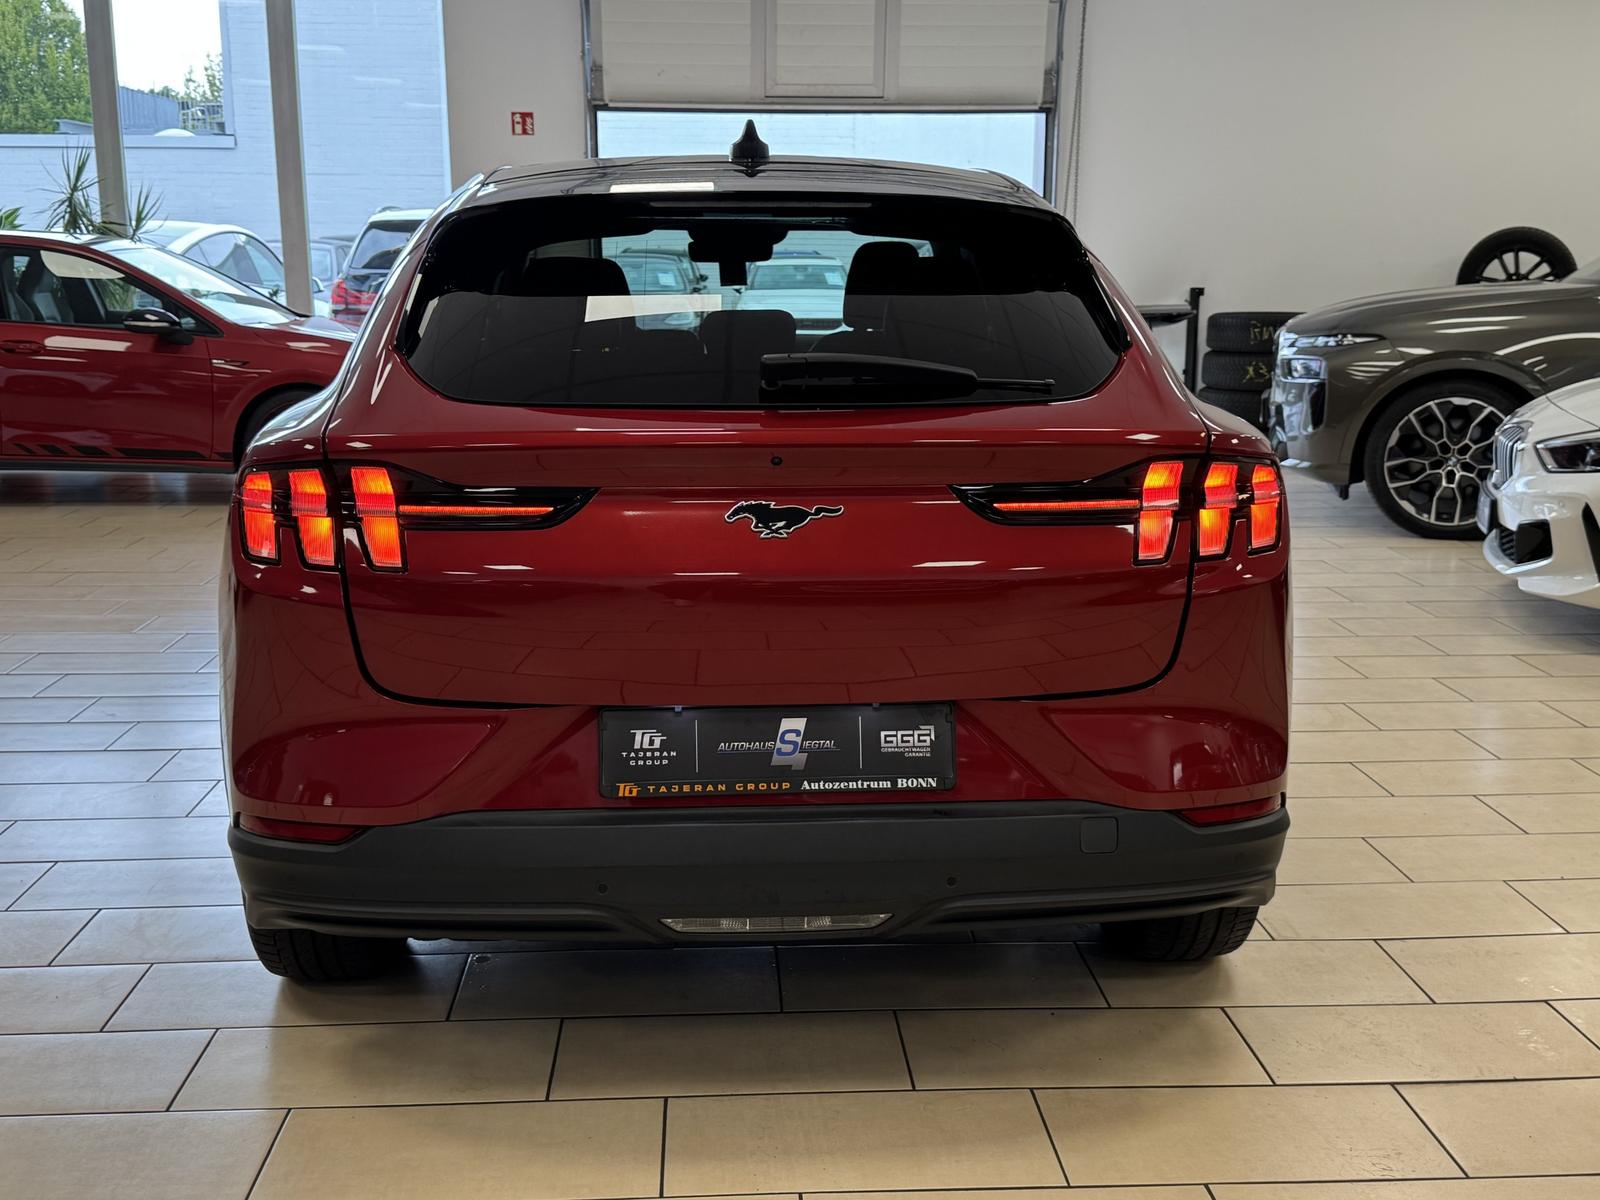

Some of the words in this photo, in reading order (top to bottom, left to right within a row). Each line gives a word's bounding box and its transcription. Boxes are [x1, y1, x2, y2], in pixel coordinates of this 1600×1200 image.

[880, 730, 931, 747] GGG
[717, 741, 775, 751] AUTOHAUS
[621, 750, 677, 758] TAJERAN
[648, 784, 727, 793] TAJERAN
[736, 783, 790, 791] GROUP
[801, 778, 892, 791] Autozentrum
[897, 777, 938, 789] BONN
